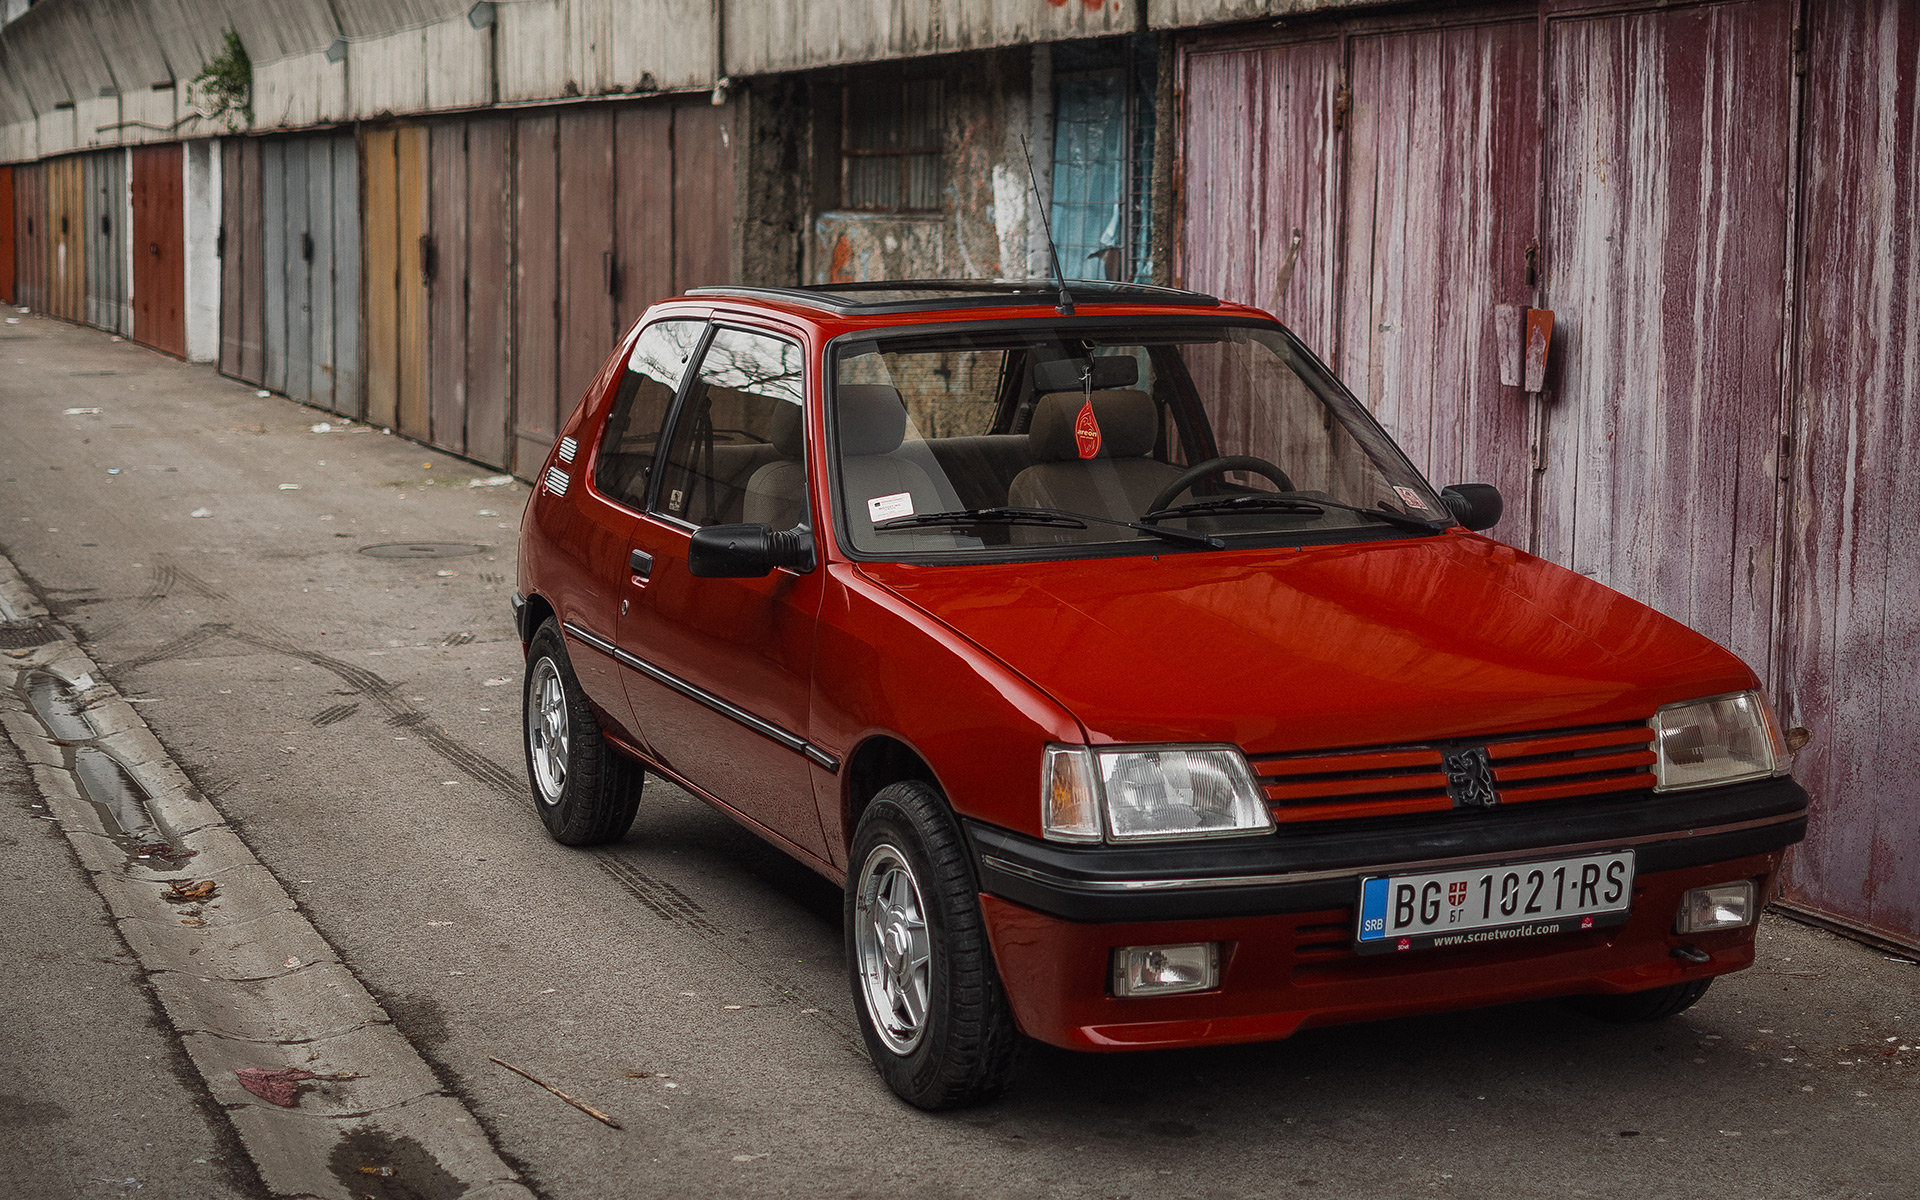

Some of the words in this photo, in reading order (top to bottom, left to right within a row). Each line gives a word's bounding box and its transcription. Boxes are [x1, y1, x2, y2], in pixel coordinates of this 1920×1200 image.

[1394, 881, 1442, 929] BG
[1364, 918, 1384, 931] SRB
[1434, 924, 1560, 947] www.scnetworld.com
